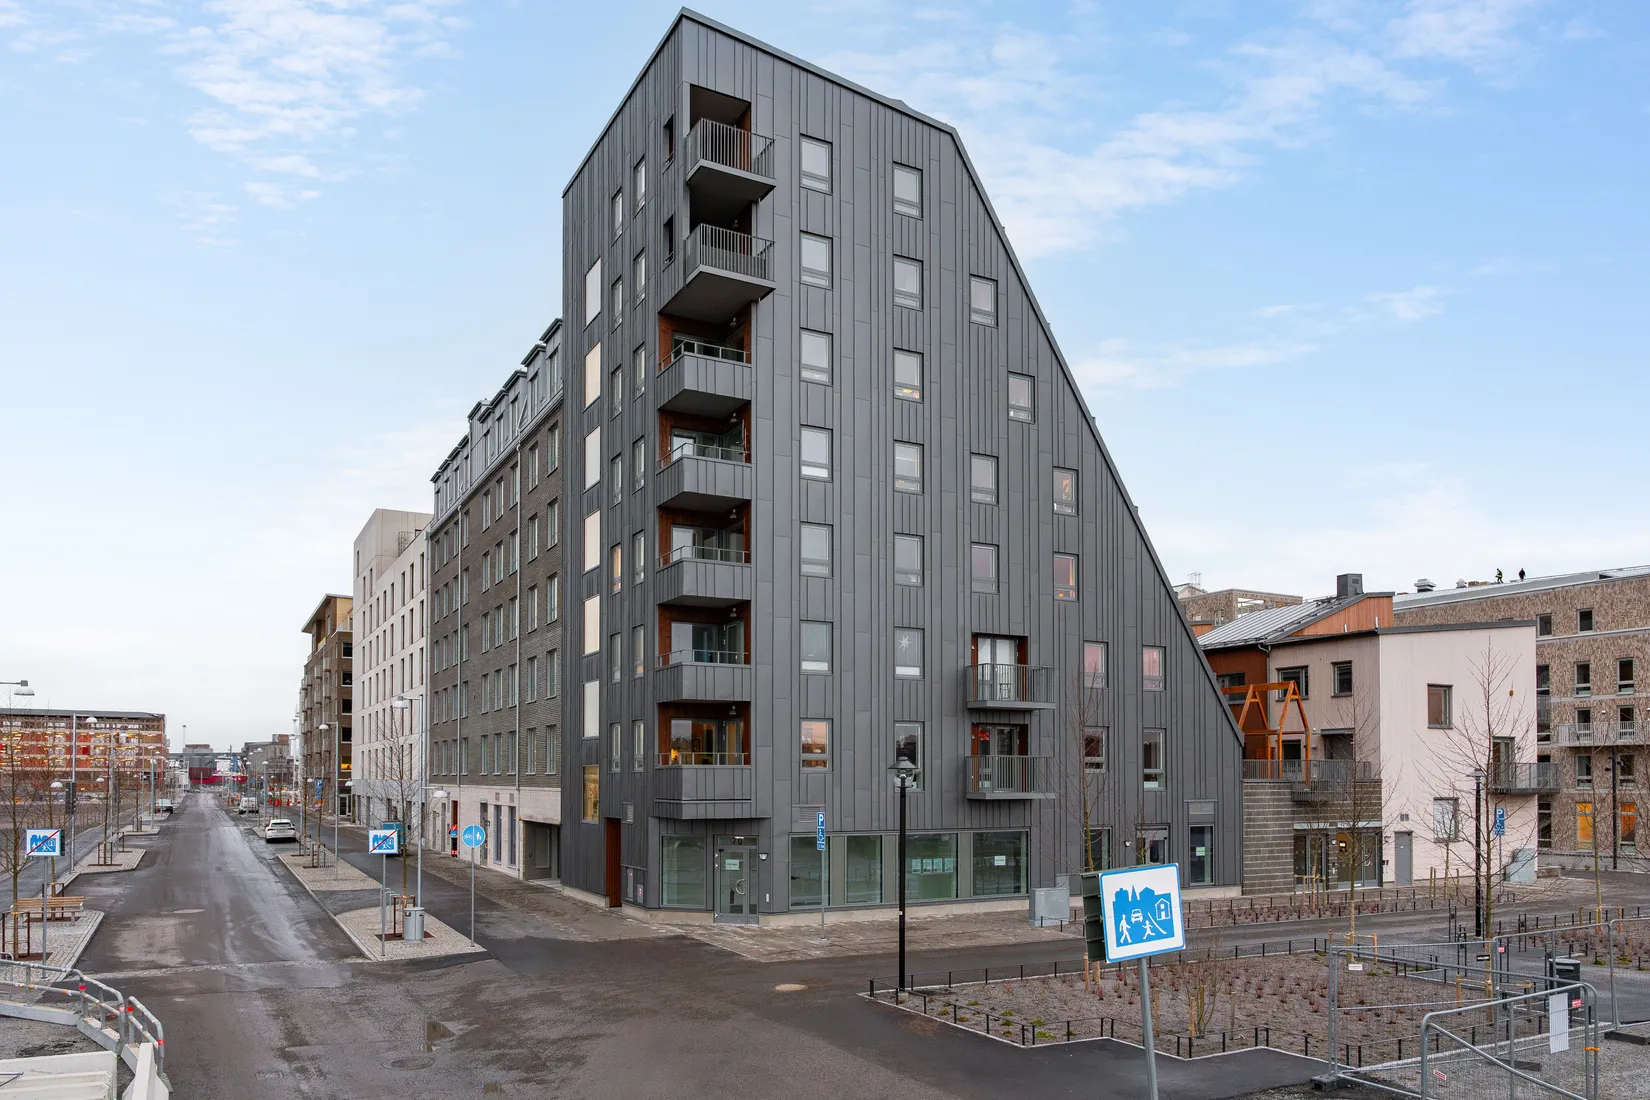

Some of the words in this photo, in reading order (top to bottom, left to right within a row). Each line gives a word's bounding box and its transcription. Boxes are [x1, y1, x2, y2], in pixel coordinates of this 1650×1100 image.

[1496, 808, 1503, 818] P
[818, 813, 824, 826] P
[732, 837, 743, 845] 70
